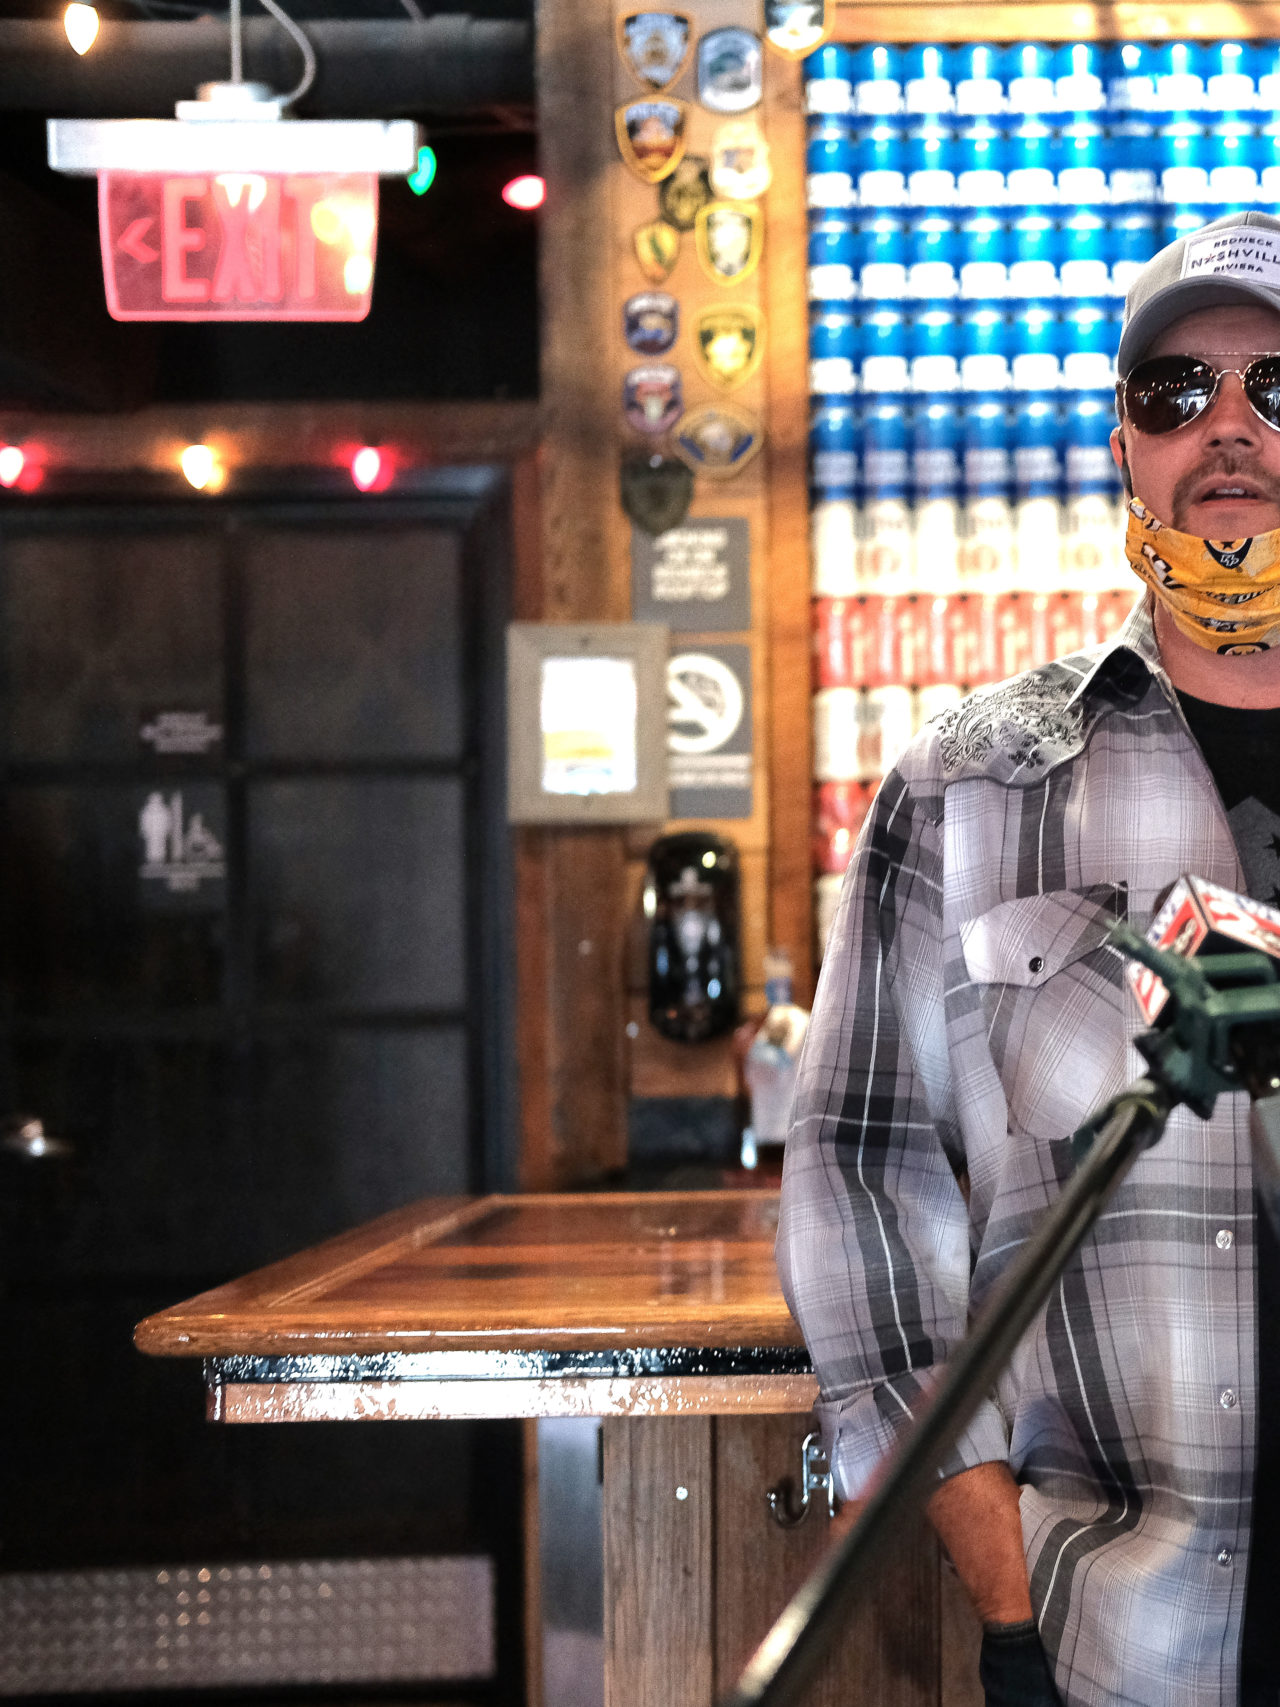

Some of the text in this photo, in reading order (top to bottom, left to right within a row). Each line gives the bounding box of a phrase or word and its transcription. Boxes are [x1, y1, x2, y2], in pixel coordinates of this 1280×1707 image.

[161, 177, 325, 302] EXIT
[1214, 237, 1273, 249] REDNECK
[1213, 262, 1264, 273] RIVIERA
